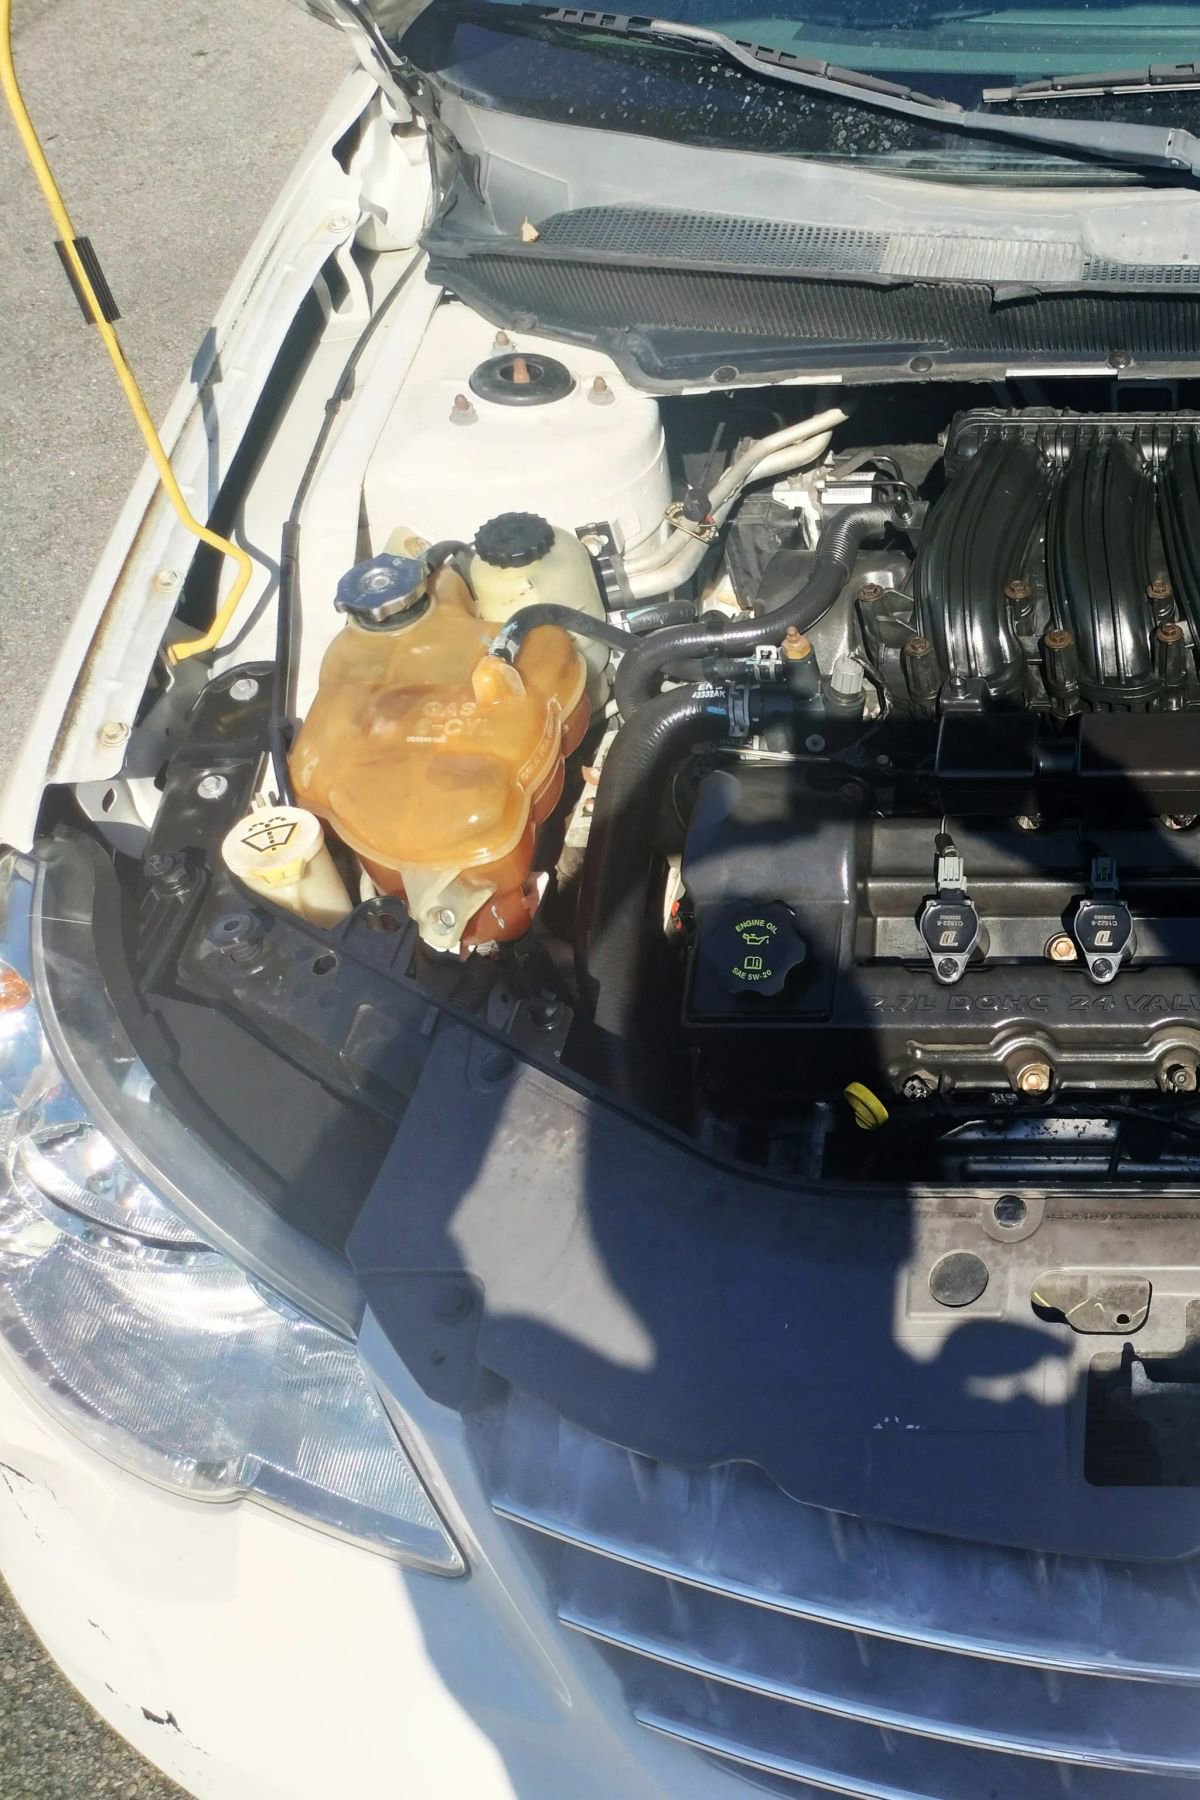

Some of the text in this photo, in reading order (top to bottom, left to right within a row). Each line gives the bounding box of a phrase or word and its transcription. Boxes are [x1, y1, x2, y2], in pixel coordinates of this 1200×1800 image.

[422, 701, 477, 718] GAS
[735, 919, 778, 935] ENGINE OIL
[732, 967, 772, 981] SAE 5W-20
[948, 993, 1051, 1012] DOHC
[1066, 993, 1116, 1012] 24
